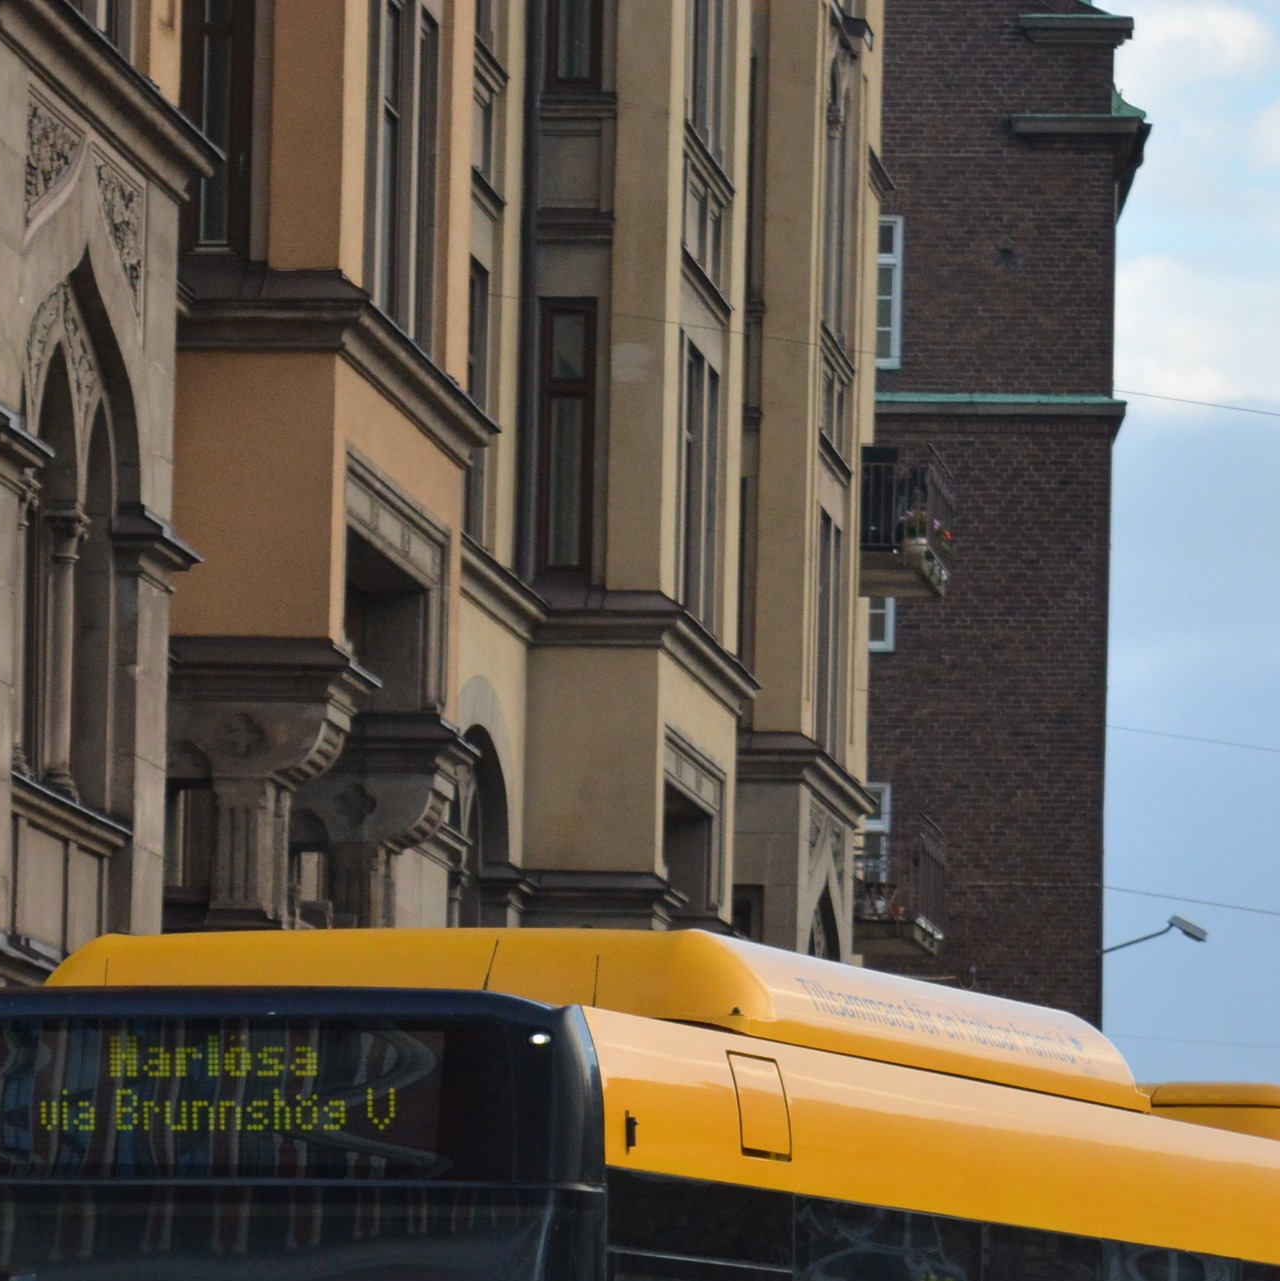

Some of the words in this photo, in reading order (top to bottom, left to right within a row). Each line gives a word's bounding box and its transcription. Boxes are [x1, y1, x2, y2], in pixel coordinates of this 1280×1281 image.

[795, 976, 915, 1031] Tillsammans
[936, 1012, 966, 1042] en
[110, 1034, 318, 1078] Harlösa
[40, 1088, 96, 1131] via
[116, 1087, 346, 1131] Brunnshög
[366, 1087, 397, 1131] V
